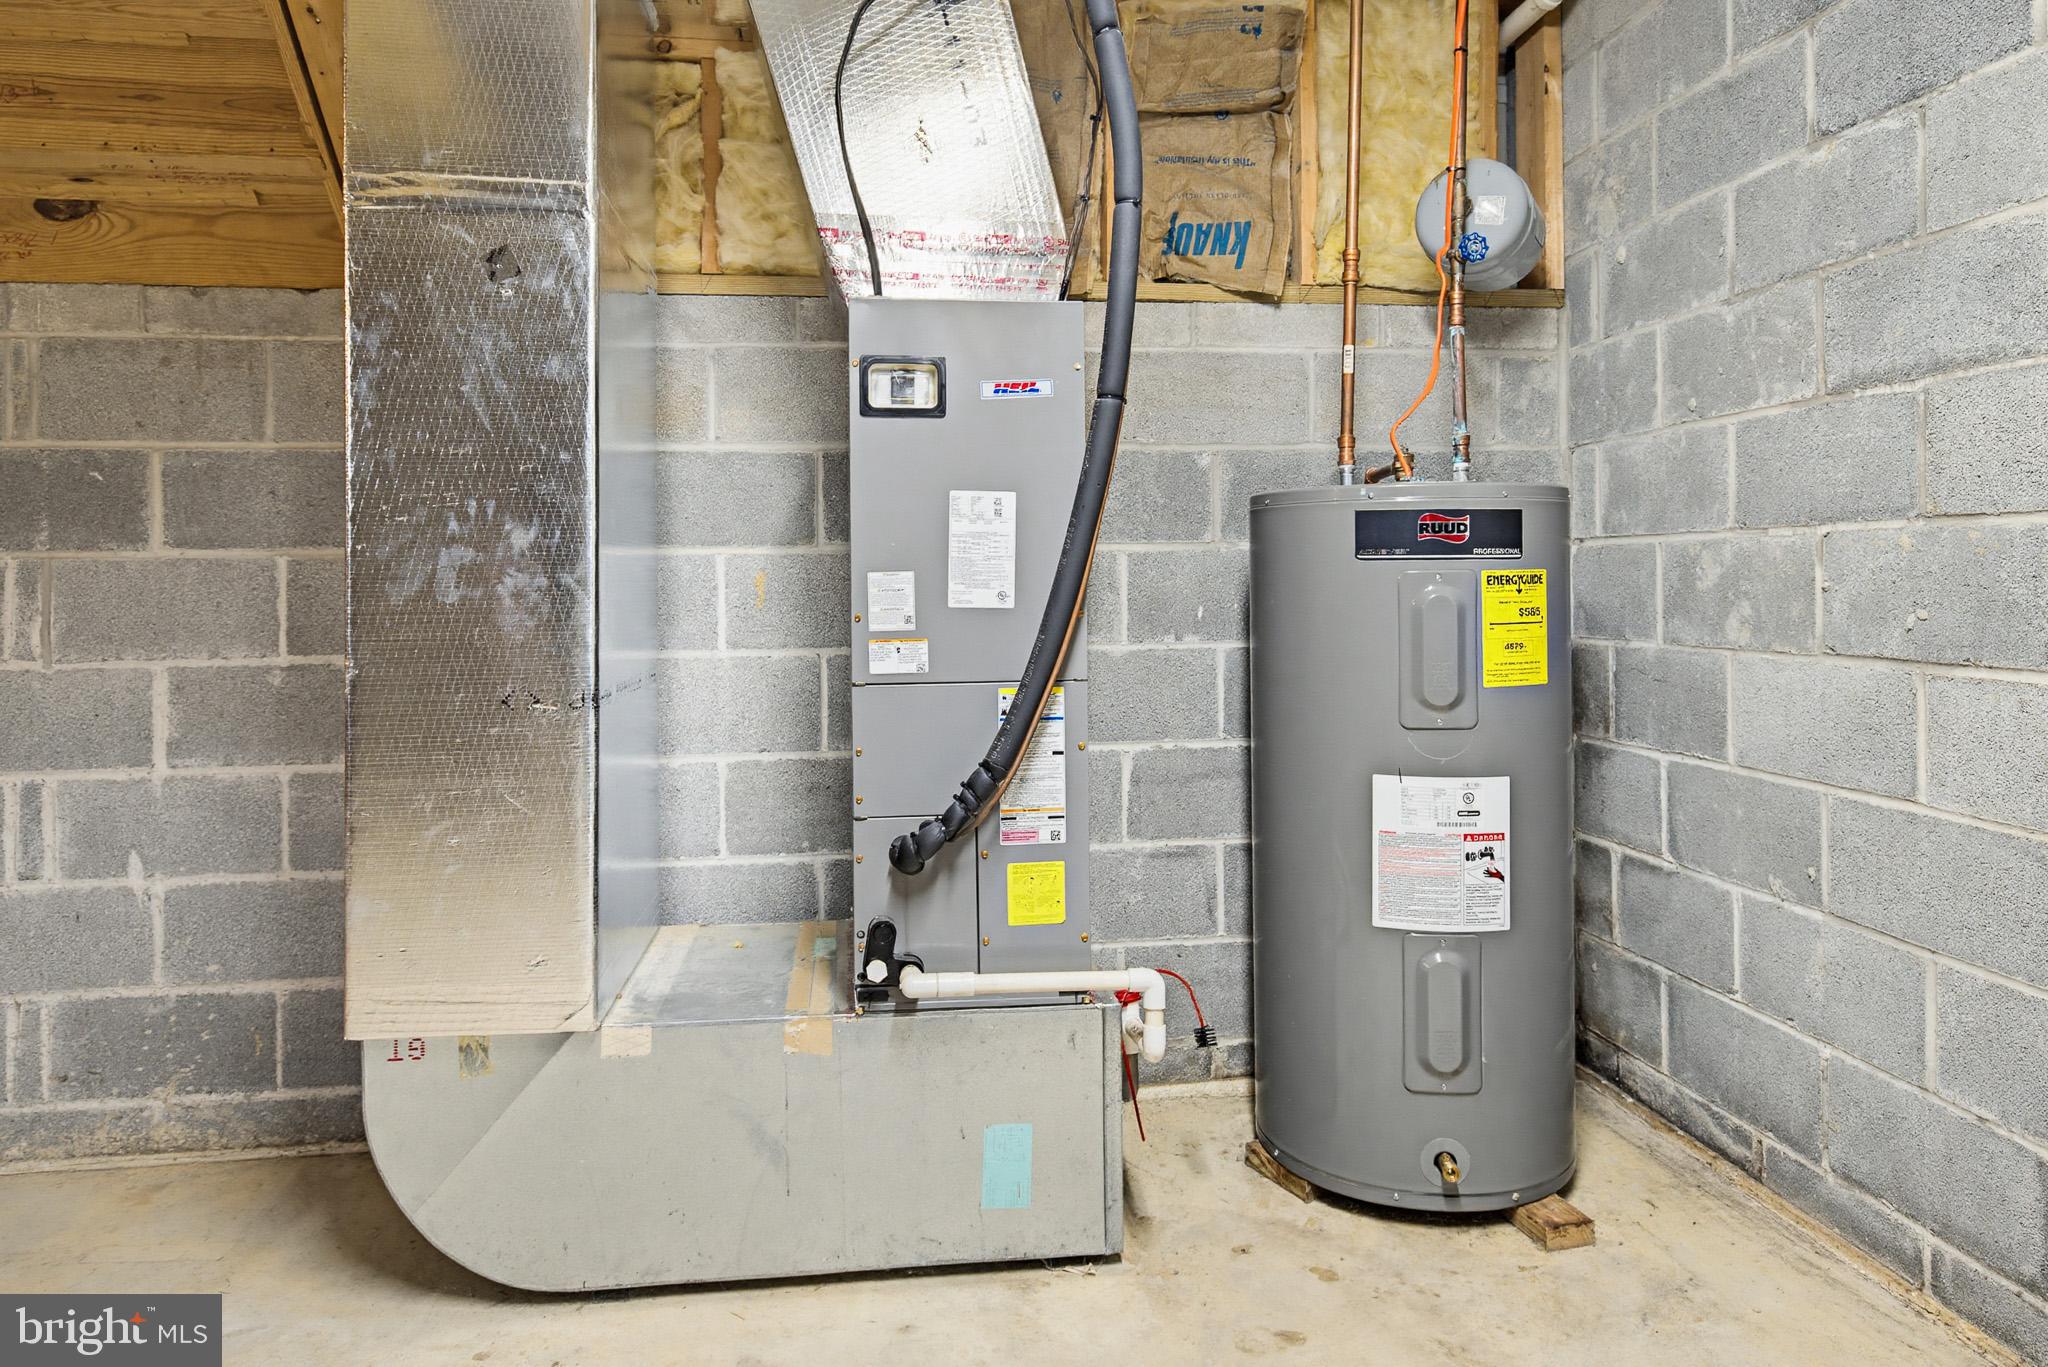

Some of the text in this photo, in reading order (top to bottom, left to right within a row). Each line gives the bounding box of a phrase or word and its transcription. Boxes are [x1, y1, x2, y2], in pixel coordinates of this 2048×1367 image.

[1161, 211, 1252, 269] KNAUF
[1419, 522, 1468, 534] RUUD
[1473, 547, 1521, 555] PROFESSIONAL
[1486, 574, 1544, 586] ENERGYGUIDE
